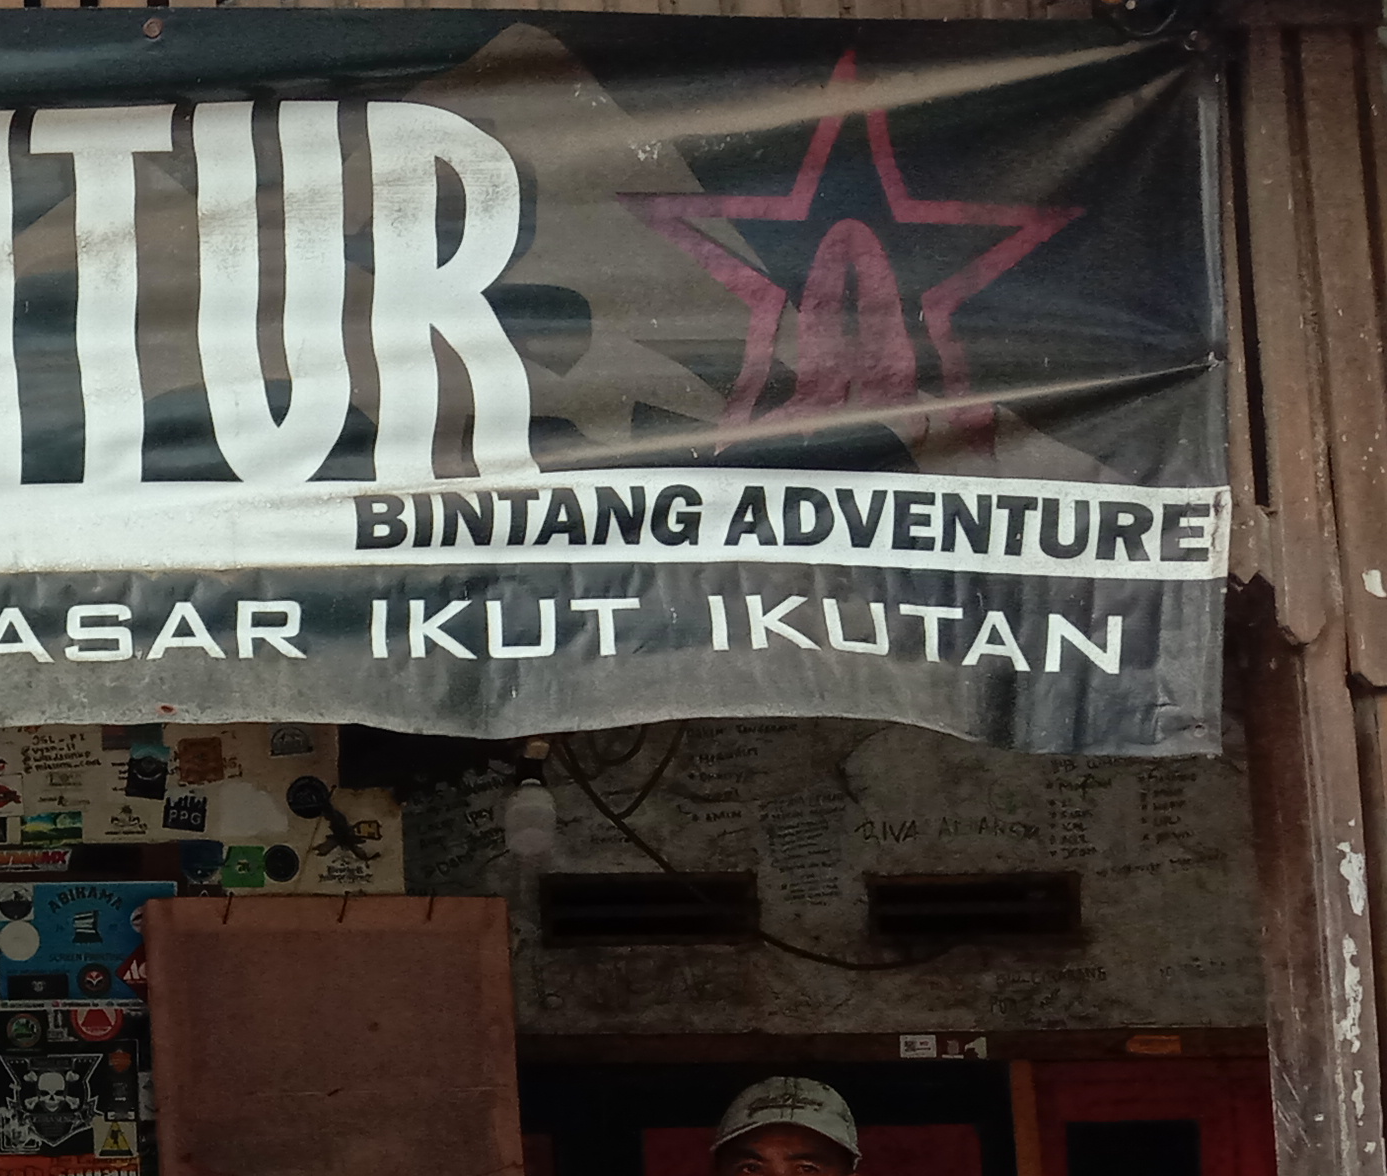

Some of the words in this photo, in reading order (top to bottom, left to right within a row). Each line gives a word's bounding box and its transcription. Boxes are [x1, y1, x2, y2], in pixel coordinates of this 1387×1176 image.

[353, 489, 704, 552] BINTANG
[724, 485, 1211, 563] ADVENTURE
[369, 596, 644, 660] IKUT
[712, 594, 1124, 677] IKUTAN
